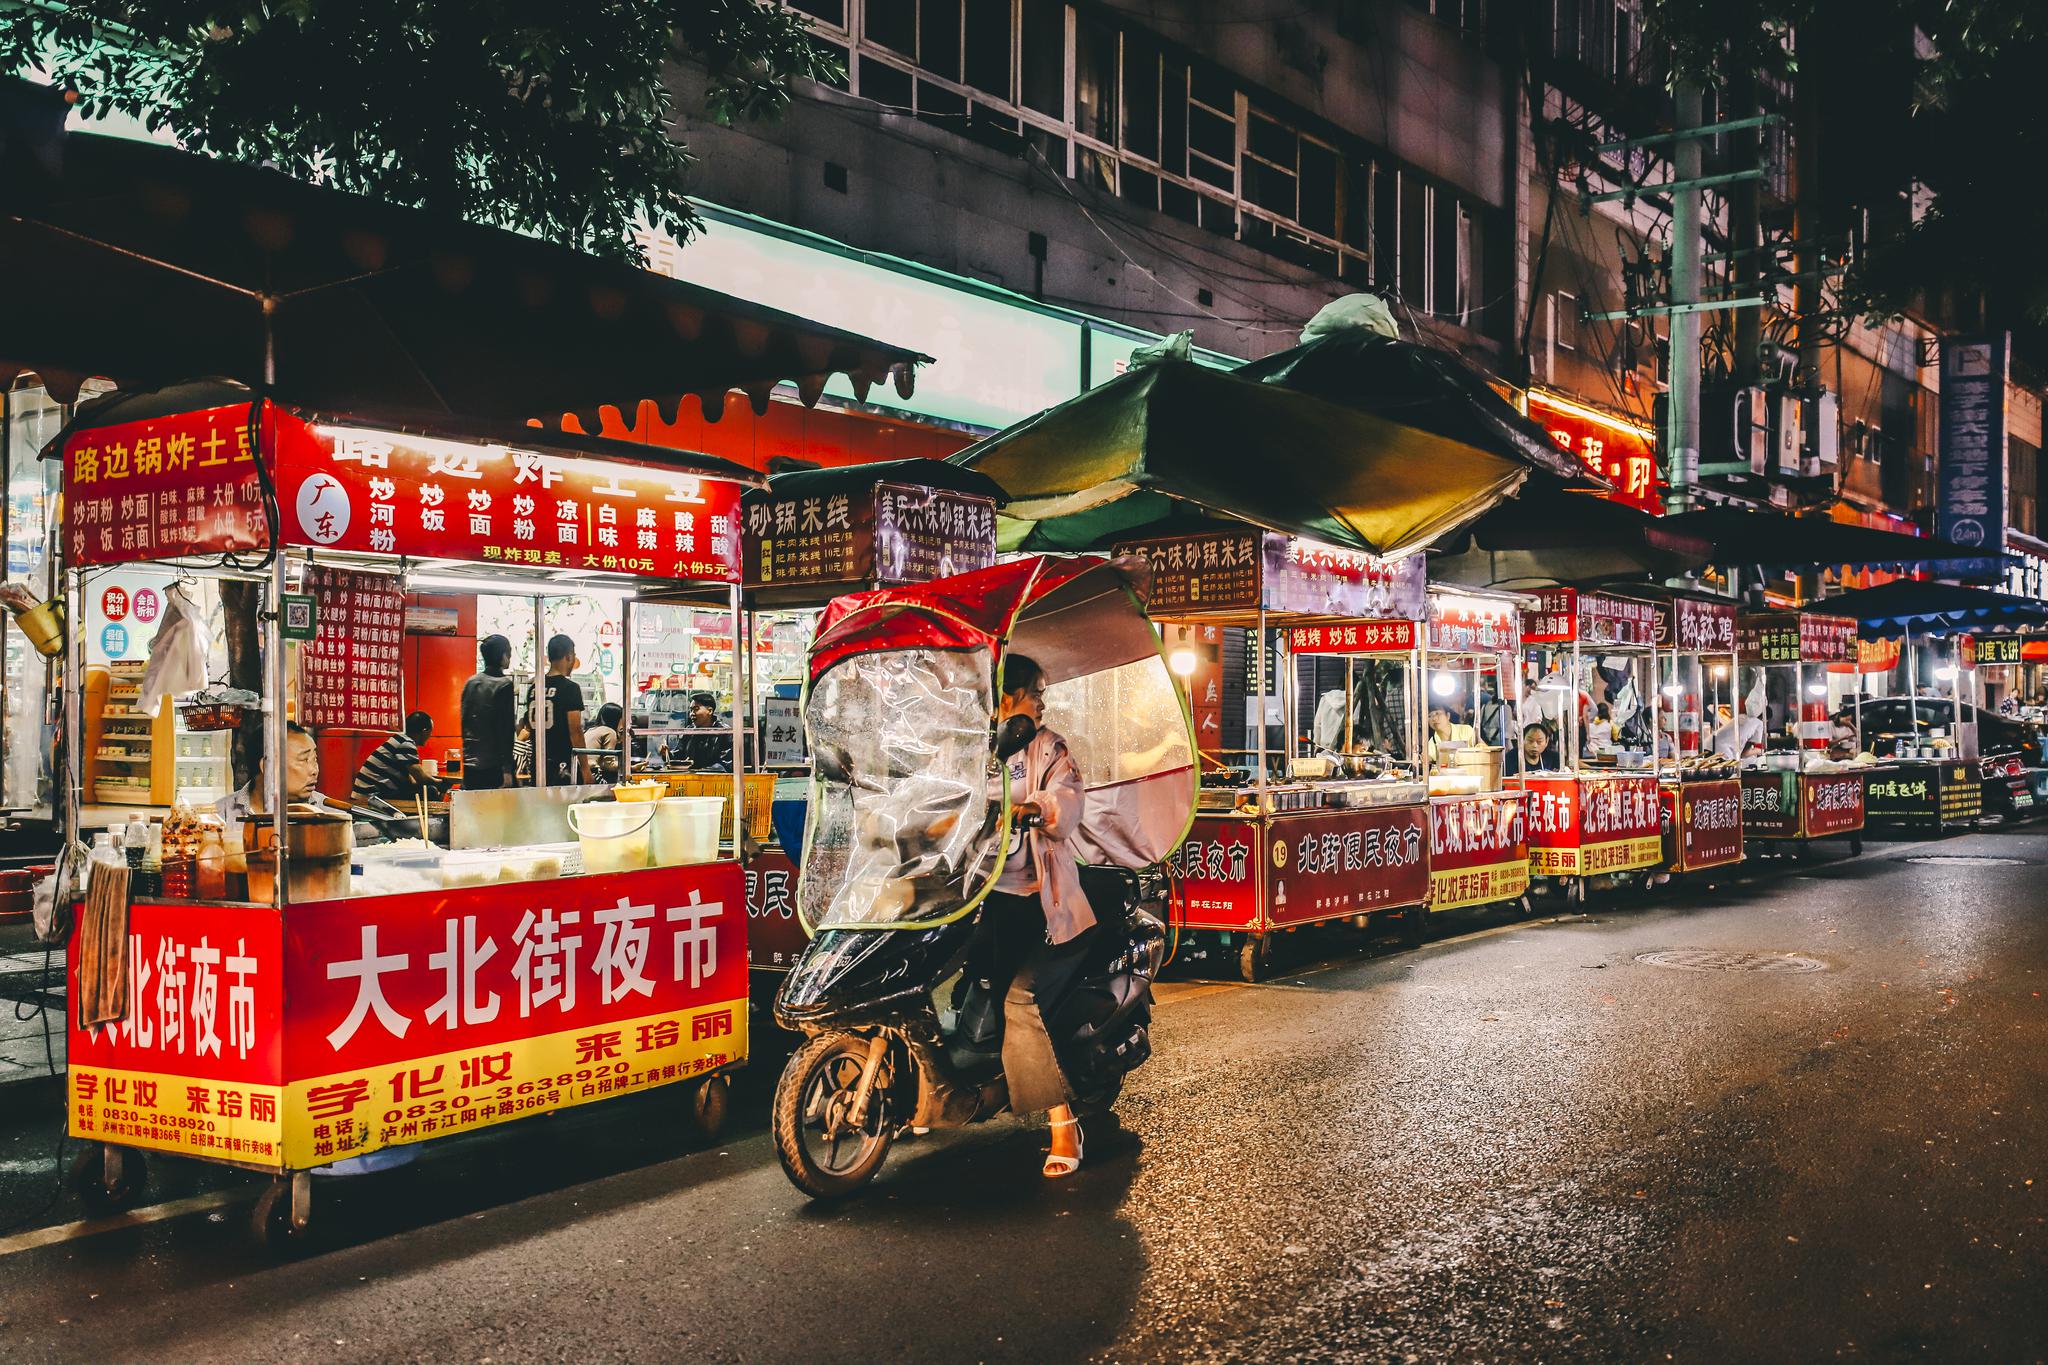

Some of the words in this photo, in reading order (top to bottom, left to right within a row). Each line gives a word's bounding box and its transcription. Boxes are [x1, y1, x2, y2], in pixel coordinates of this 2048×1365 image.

[73, 426, 262, 484] 路边锅炸土豆
[73, 498, 113, 525] 炒河粉
[121, 493, 149, 521] 炒面
[213, 483, 234, 507] 大份
[369, 476, 396, 552] 炒河粉
[419, 482, 446, 532] 炒饭
[468, 488, 492, 536] 炒面
[740, 493, 851, 537] 砂锅米线
[121, 523, 149, 550] 凉面
[214, 511, 235, 535] 小份
[246, 509, 264, 532] 5元
[513, 494, 536, 541] 炒粉
[556, 499, 579, 545] 凉面
[598, 503, 618, 548] 白味
[636, 507, 657, 551] 麻辣
[674, 511, 695, 554] 酸辣
[710, 514, 729, 556] 甜酸
[583, 553, 655, 571] 大份10元
[673, 560, 729, 576] 小份5元
[137, 594, 155, 607] 会员
[1293, 628, 1322, 647] 烧烤
[1329, 627, 1358, 646] 炒饭
[1365, 624, 1410, 645] 炒米粉
[1535, 616, 1569, 635] 热狗肠
[1869, 780, 1928, 801] 印度飞饼
[1274, 846, 1286, 862] 19
[1297, 822, 1422, 875] 北街便民夜市
[1529, 851, 1576, 868] 来玲丽
[326, 889, 724, 1052] 大北街夜市
[74, 934, 258, 1060] 北街夜市
[575, 1008, 733, 1065] 来玲丽
[186, 1086, 276, 1123] 来玲丽
[383, 1062, 630, 1124] 0830-3638920
[103, 1107, 216, 1132] 0830-3638920
